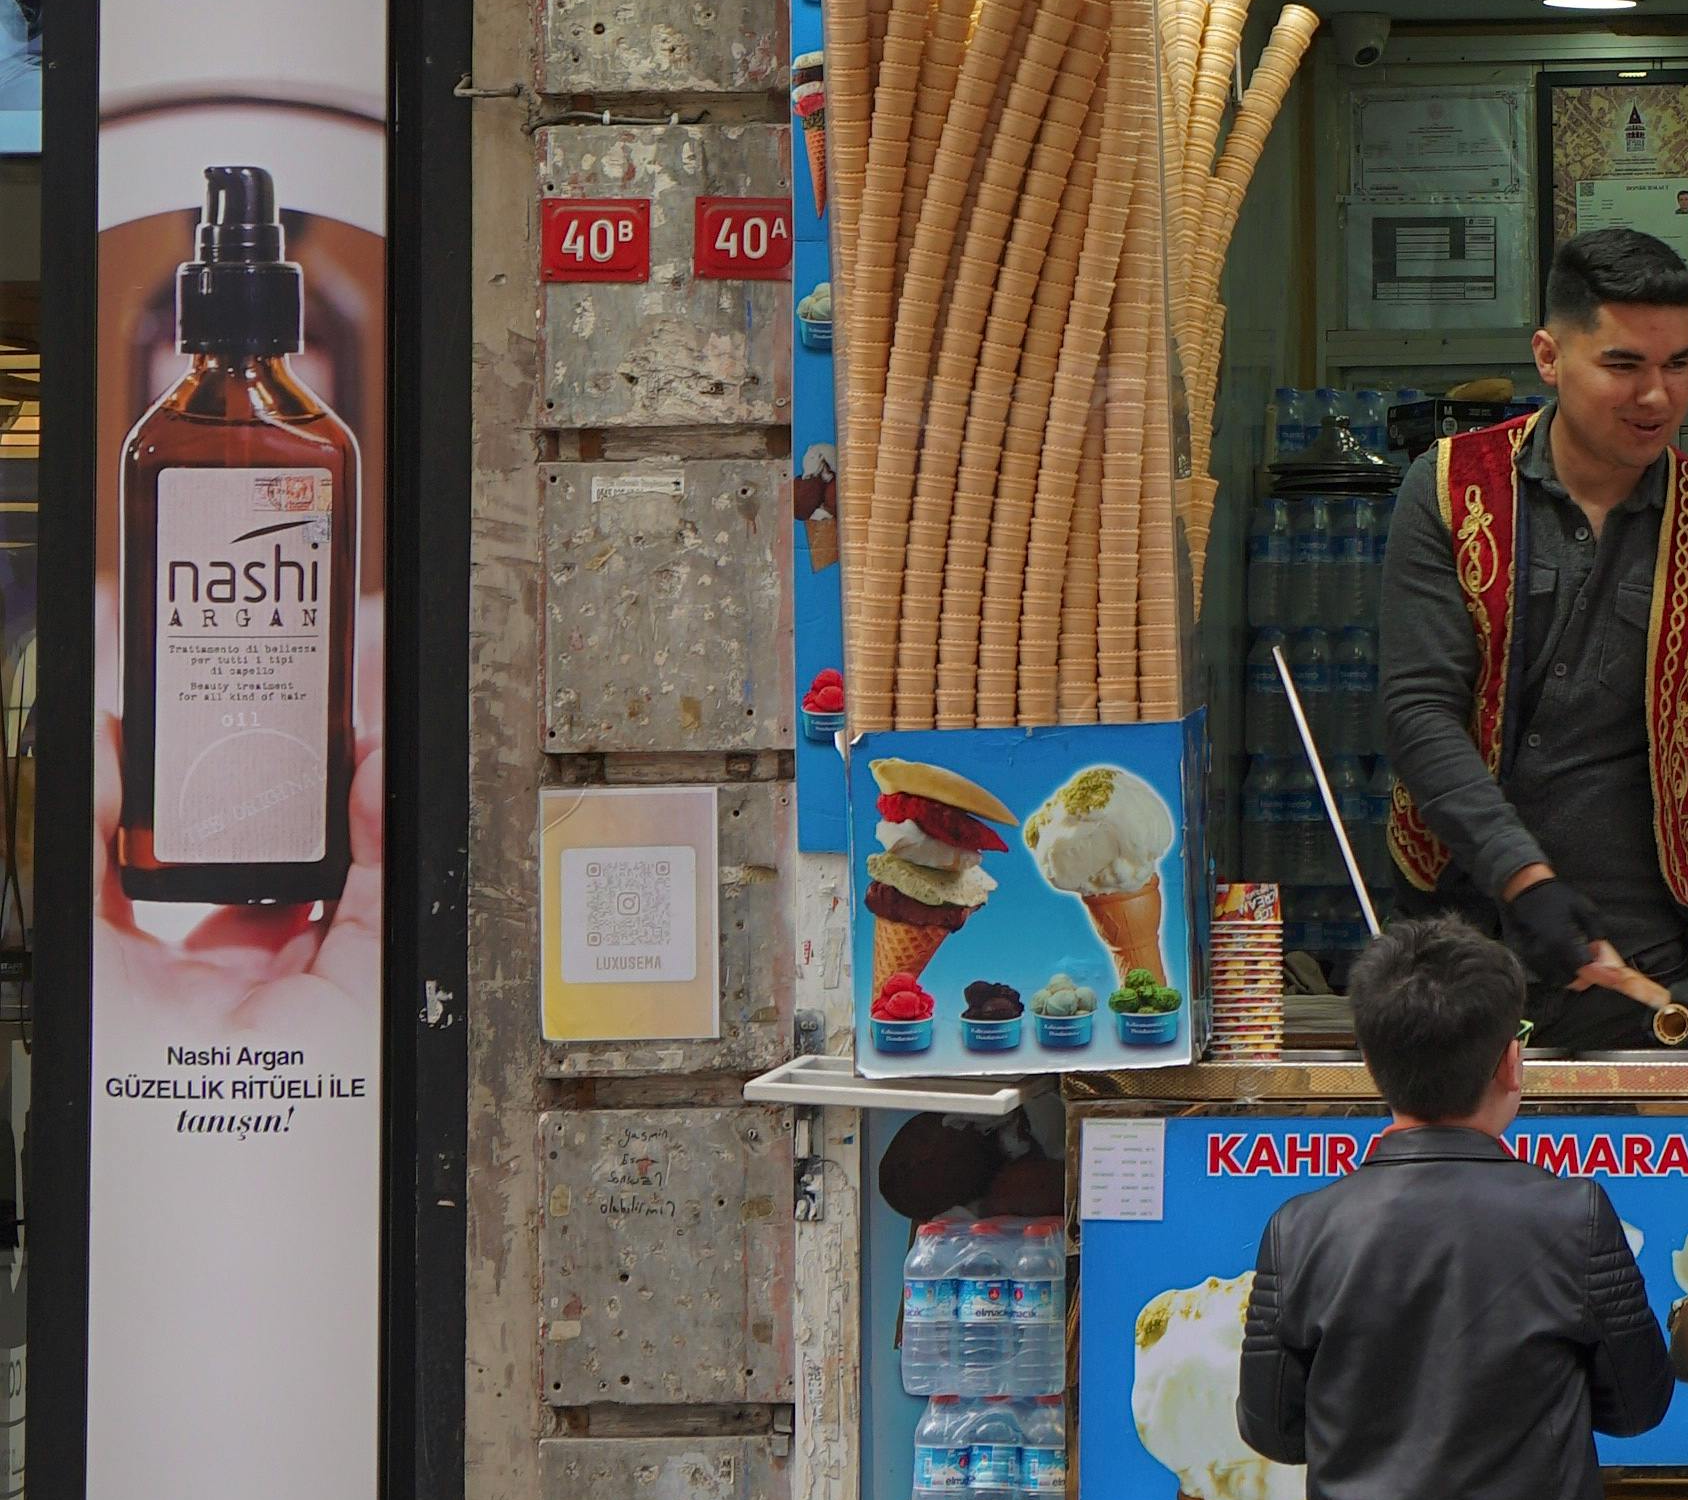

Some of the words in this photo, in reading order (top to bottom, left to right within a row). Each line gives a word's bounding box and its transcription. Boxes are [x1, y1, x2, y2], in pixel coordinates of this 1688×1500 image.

[168, 543, 319, 603] nashi
[168, 609, 317, 628] ARGAN
[167, 1046, 231, 1066] Nashi
[237, 1046, 304, 1070] Argan
[105, 1074, 224, 1099] GÜZELLİK
[232, 1074, 322, 1099] RİTÜELİ
[329, 1073, 365, 1097] İLE
[176, 1104, 295, 1141] tanışın!
